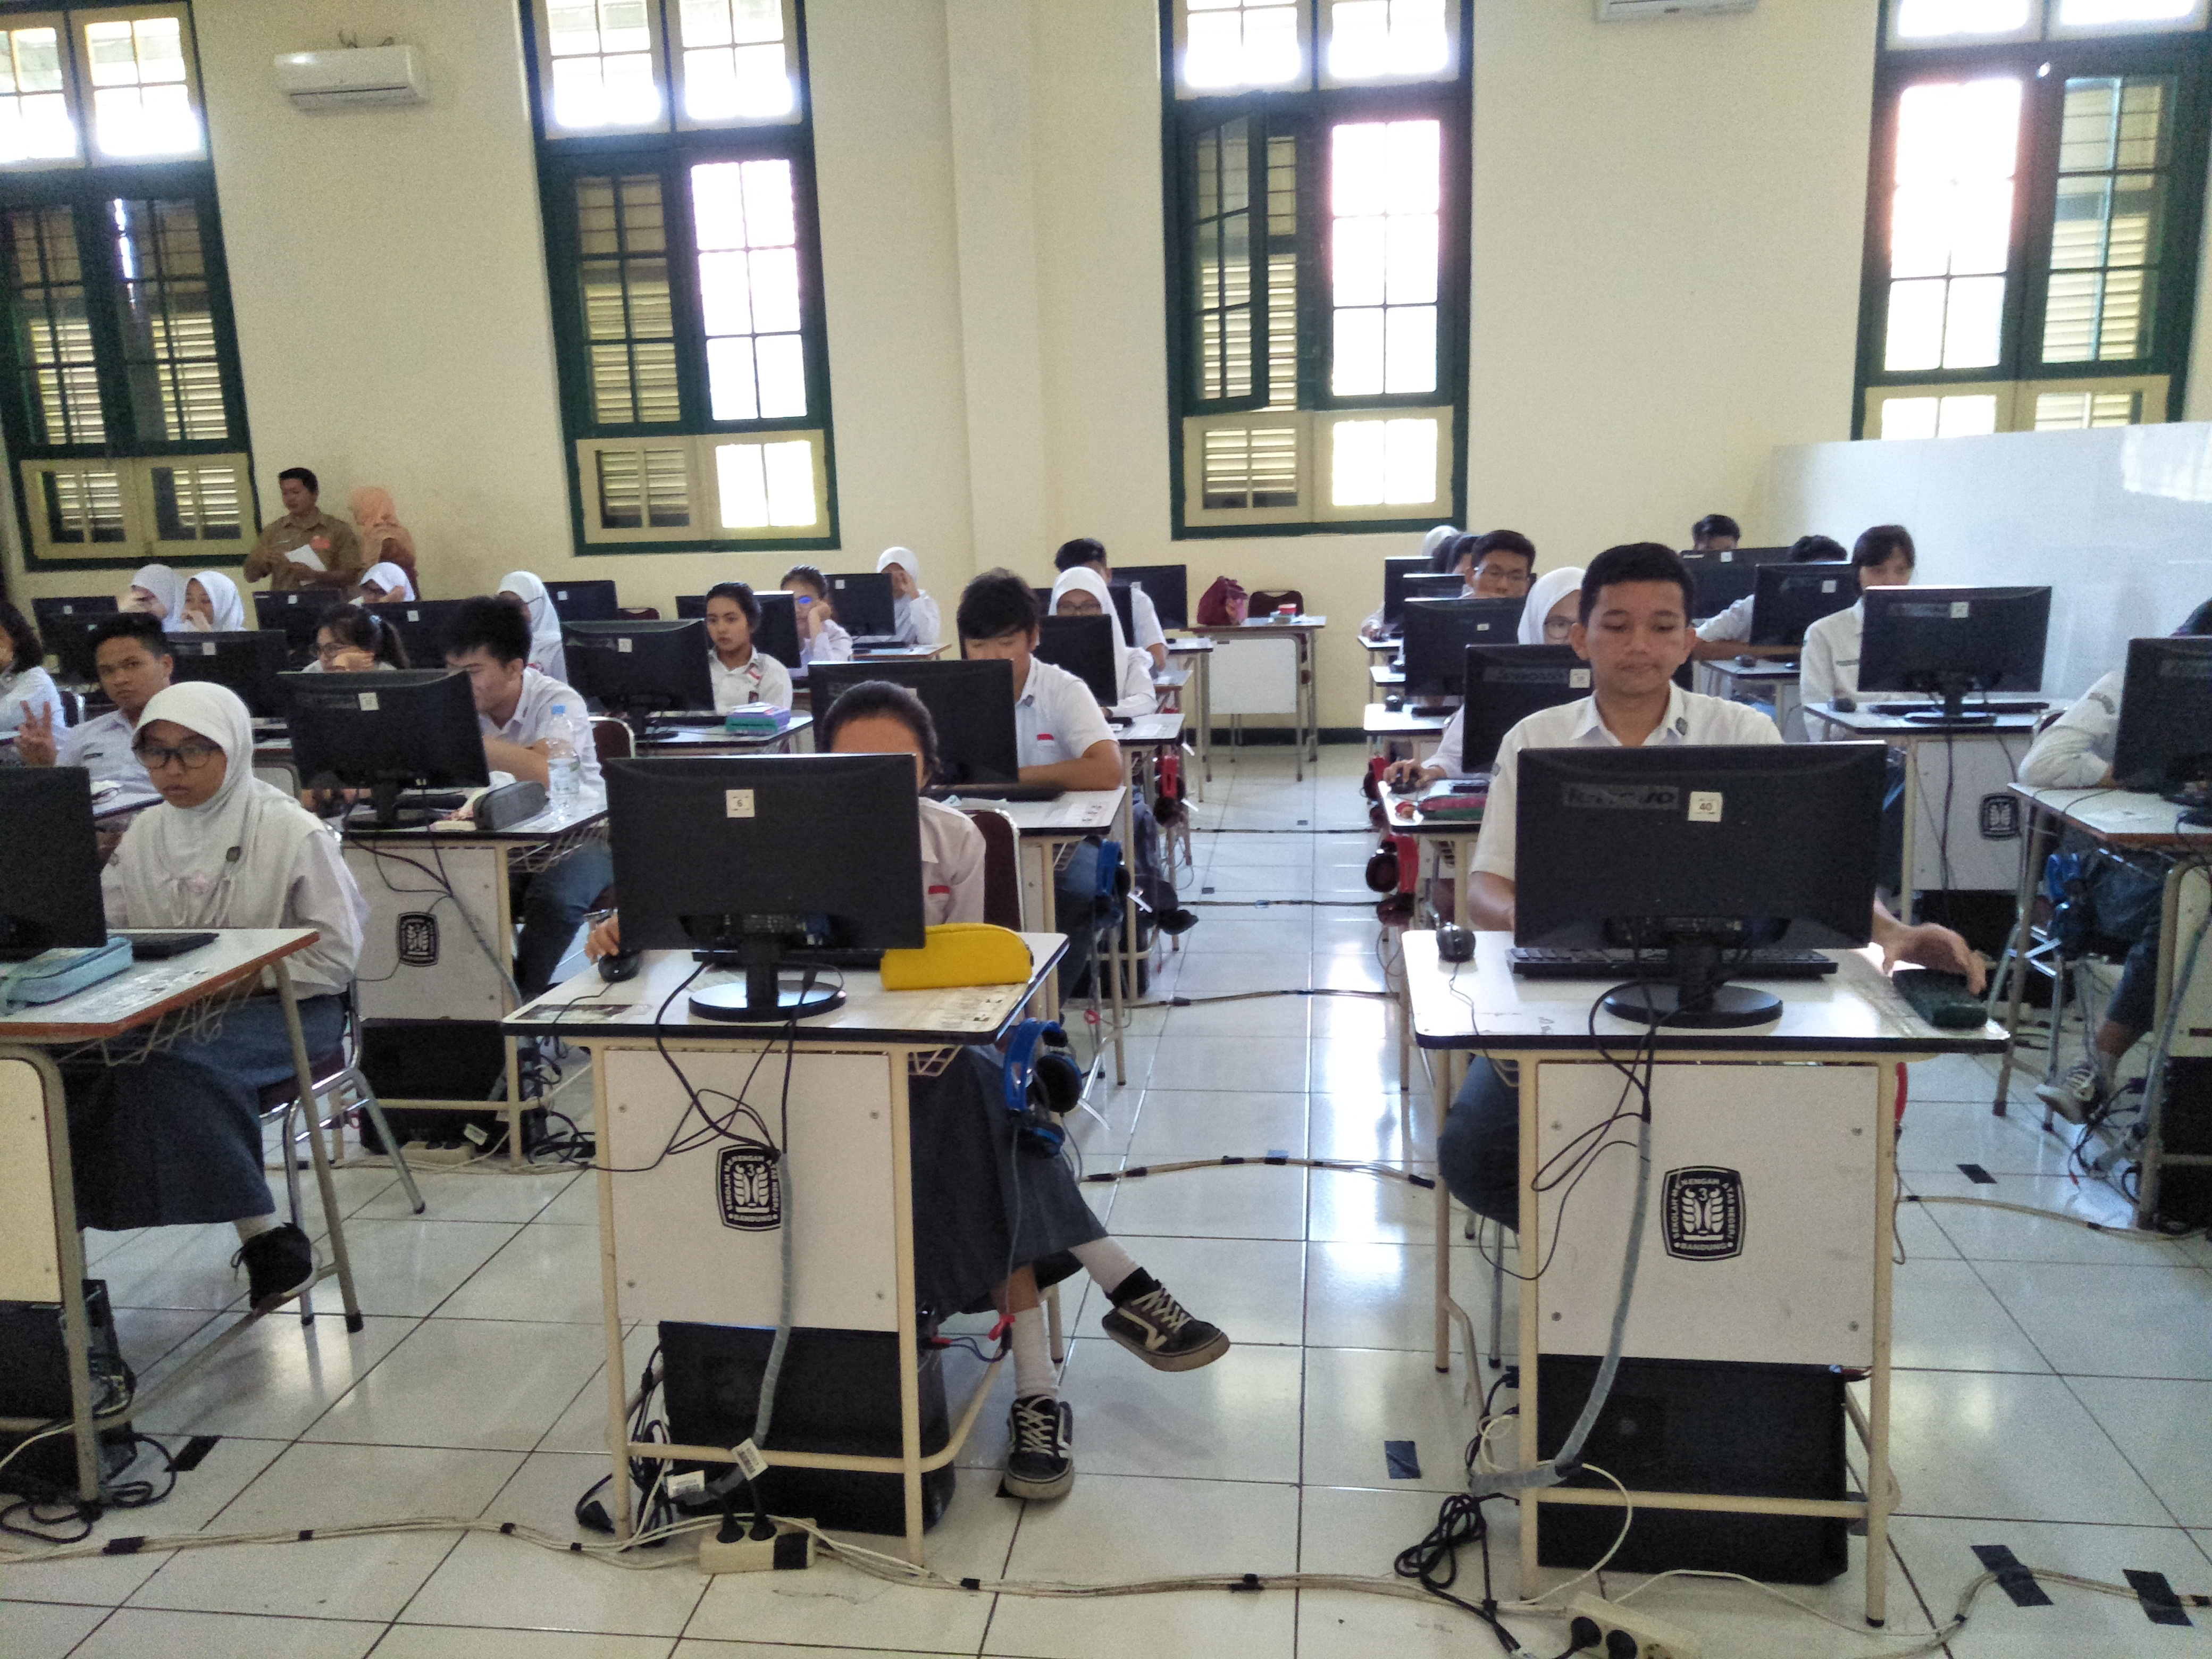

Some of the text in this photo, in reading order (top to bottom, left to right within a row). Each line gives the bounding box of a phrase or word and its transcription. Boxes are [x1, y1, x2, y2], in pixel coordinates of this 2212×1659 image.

[1699, 802, 1713, 811] 40
[747, 1164, 755, 1177] 3
[724, 1174, 733, 1211] SEKOLAH
[1698, 1187, 1708, 1201] 3
[1671, 1199, 1680, 1239] SEKOLAH
